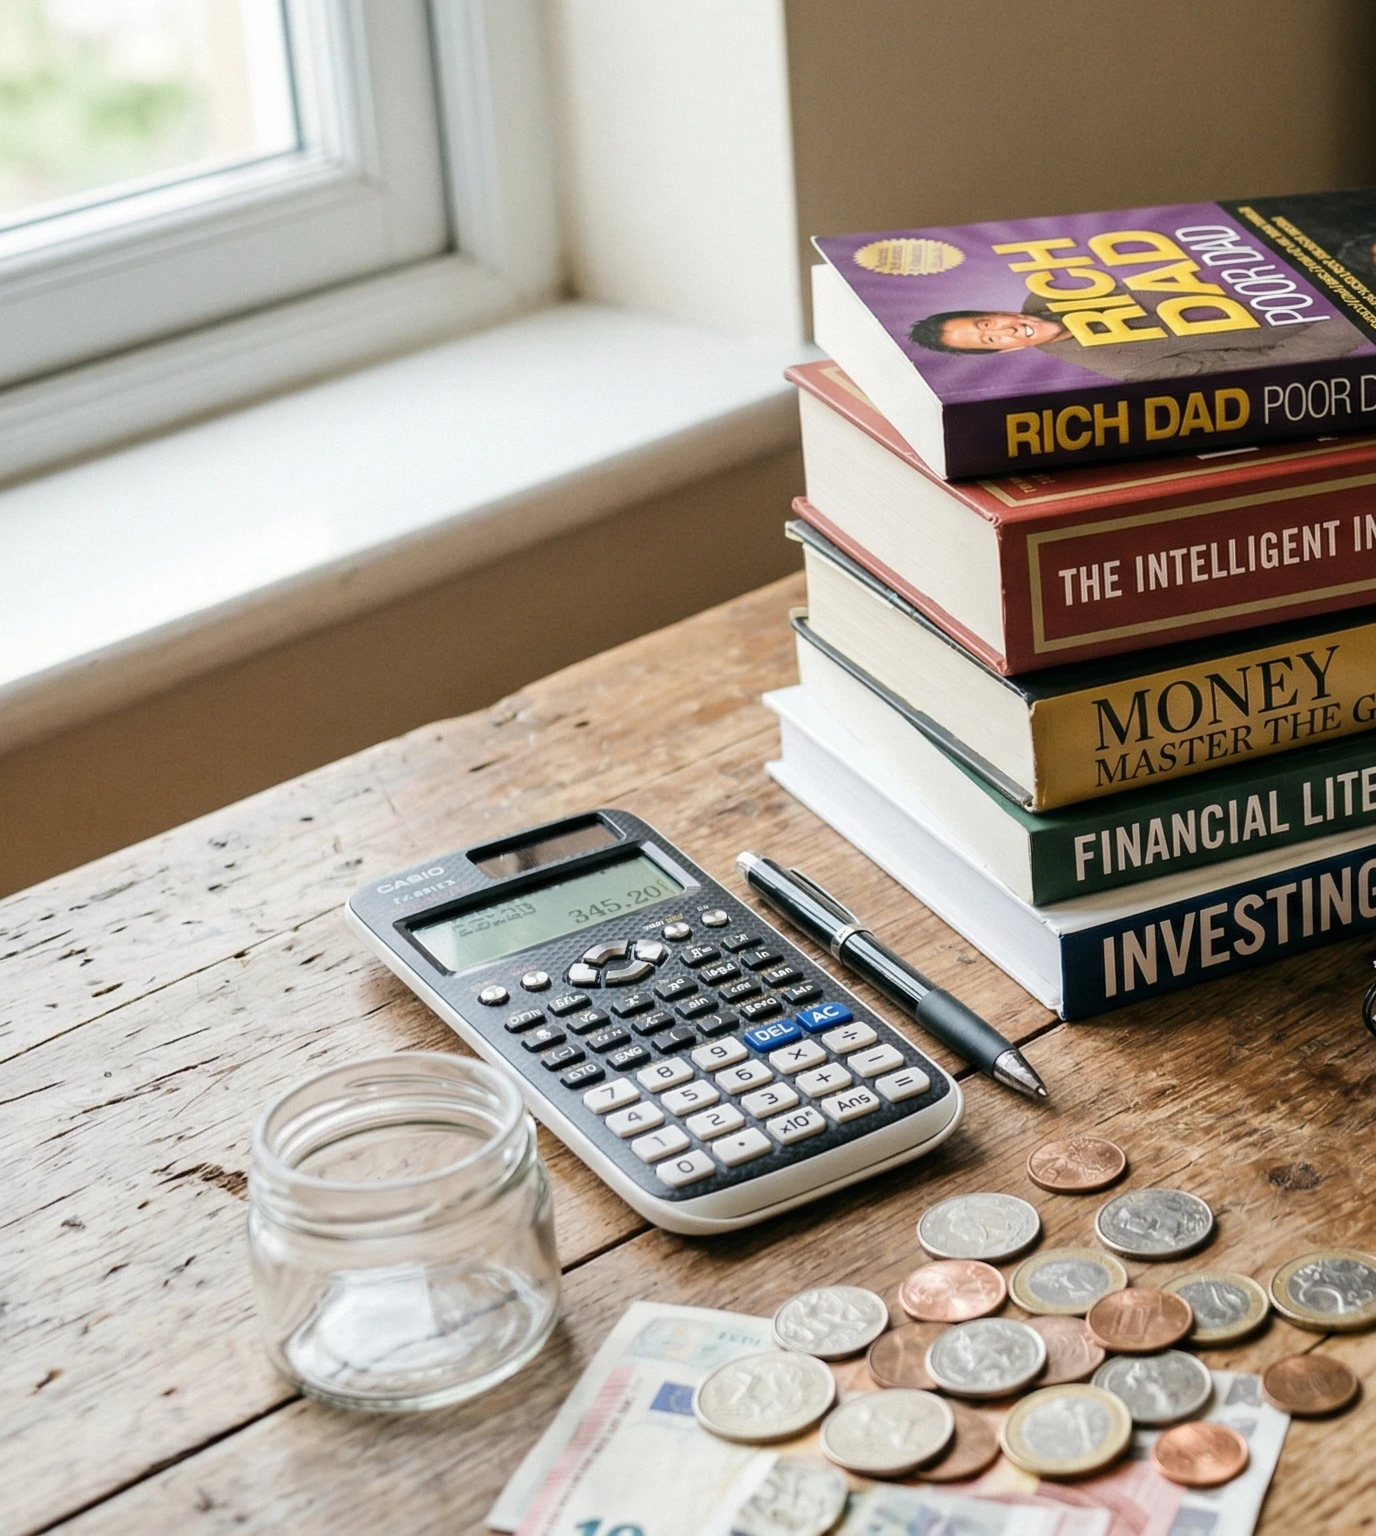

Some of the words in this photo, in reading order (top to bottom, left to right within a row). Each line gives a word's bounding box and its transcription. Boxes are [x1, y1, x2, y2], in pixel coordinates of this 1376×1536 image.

[1174, 224, 1265, 267] DAD
[991, 237, 1168, 347] RICH
[1091, 230, 1261, 337] DAD
[1220, 264, 1331, 326] POOR
[1006, 400, 1129, 458] RICH
[1144, 387, 1250, 441] DAD
[1264, 377, 1351, 424] POOR
[1058, 560, 1122, 606] THE
[1135, 520, 1340, 593] INTELLIGENT
[1091, 644, 1341, 752] MONEY
[1095, 725, 1254, 788] MASTER
[1263, 703, 1342, 745] THE
[1074, 790, 1290, 881] FINANCIAL
[812, 1005, 840, 1023] AC
[754, 1023, 794, 1042] DEL
[710, 1046, 727, 1058] 9
[656, 1066, 674, 1078] 8
[735, 1068, 753, 1081] 6
[600, 1087, 615, 1099] 7
[681, 1089, 699, 1101] 5
[760, 1092, 779, 1105] 3
[837, 1094, 871, 1112] Ans
[627, 1111, 643, 1122] 4
[706, 1113, 726, 1126] 2
[651, 1136, 667, 1147] 1
